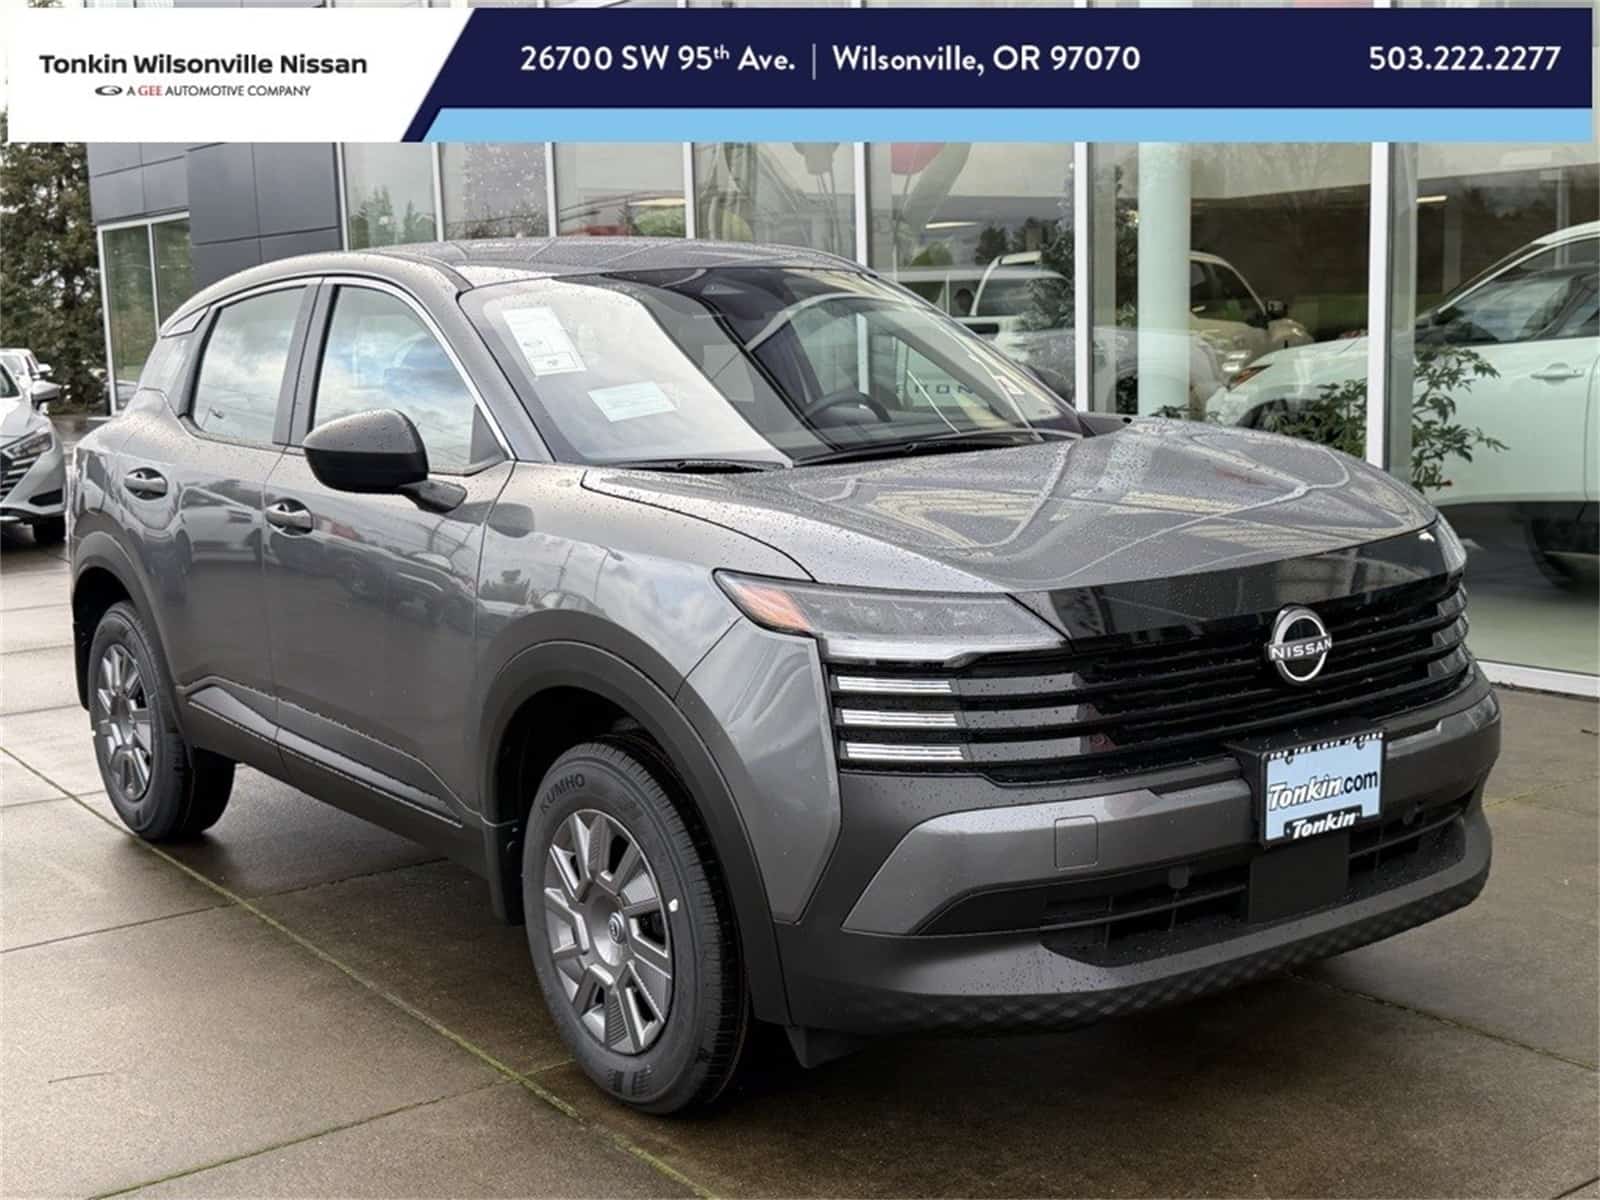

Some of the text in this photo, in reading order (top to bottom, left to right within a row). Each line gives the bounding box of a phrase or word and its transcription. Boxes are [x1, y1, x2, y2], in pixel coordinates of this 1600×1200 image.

[1270, 639, 1332, 660] NISSAN
[540, 773, 585, 816] KUMHO
[1268, 771, 1378, 812] Tonkin.com
[1292, 811, 1357, 839] Tonkin
